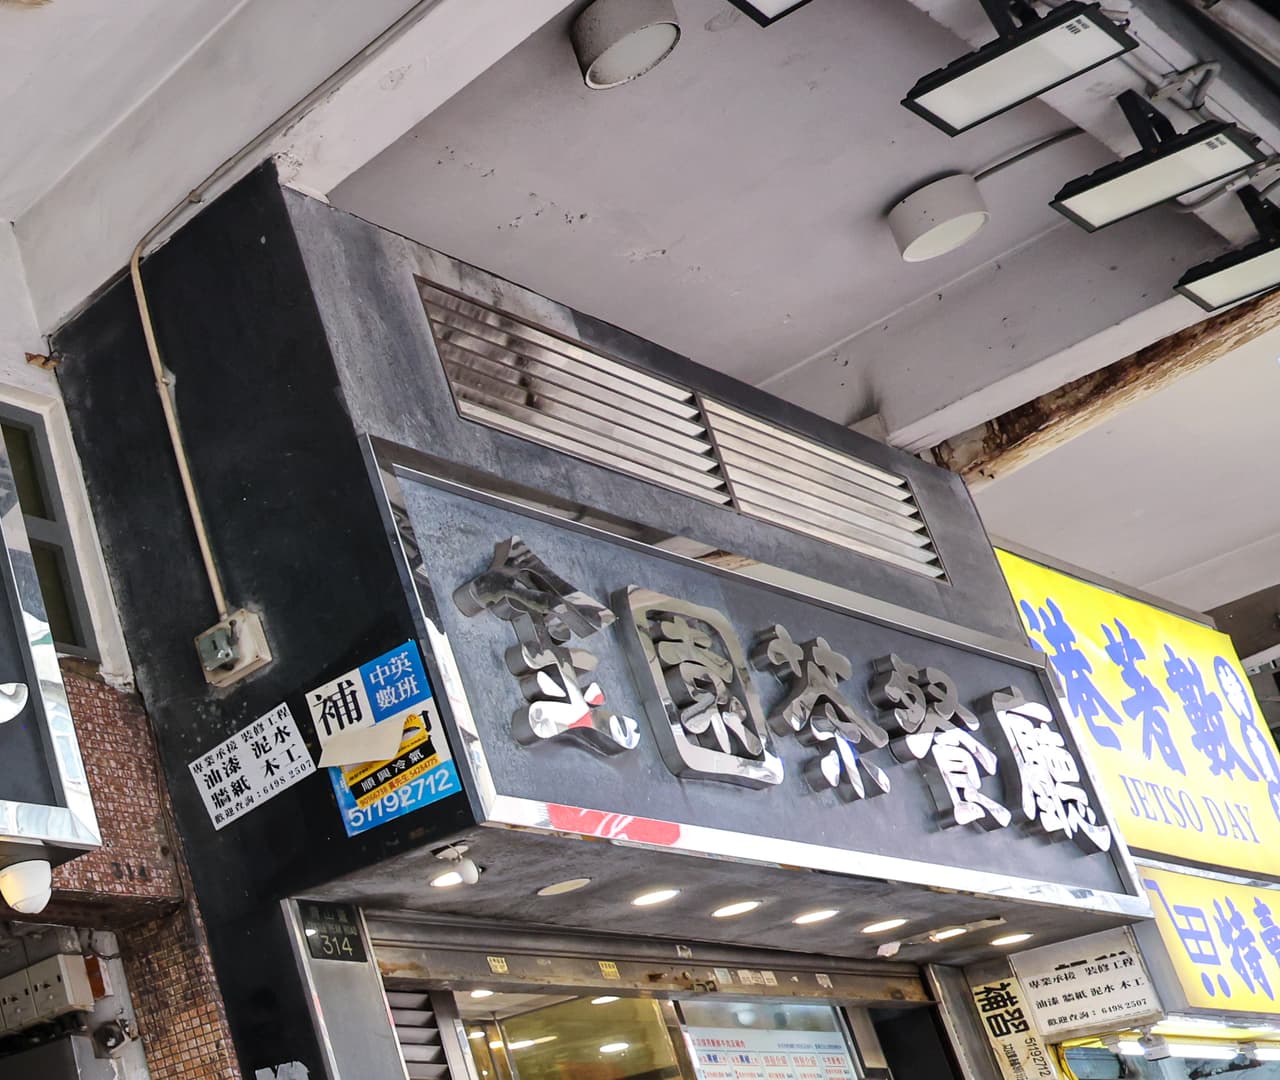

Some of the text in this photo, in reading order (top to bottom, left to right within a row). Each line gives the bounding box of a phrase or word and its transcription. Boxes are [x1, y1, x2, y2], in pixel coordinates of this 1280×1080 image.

[370, 652, 413, 686] 中英
[313, 680, 363, 736] 補
[376, 674, 420, 711] 數班
[452, 536, 1111, 856] 金園茶餐廳
[204, 726, 291, 789] 油漆 泥水
[261, 743, 301, 778] 木工
[263, 777, 286, 794] 6498
[288, 760, 312, 779] 2507
[1119, 774, 1261, 844] JETSO DAY
[320, 935, 352, 956] 314
[974, 982, 1030, 1038] 補習
[1035, 997, 1060, 1009] 油漆
[1091, 983, 1115, 997] 泥水
[1101, 1004, 1123, 1015] 6498
[1126, 999, 1148, 1010] 2507
